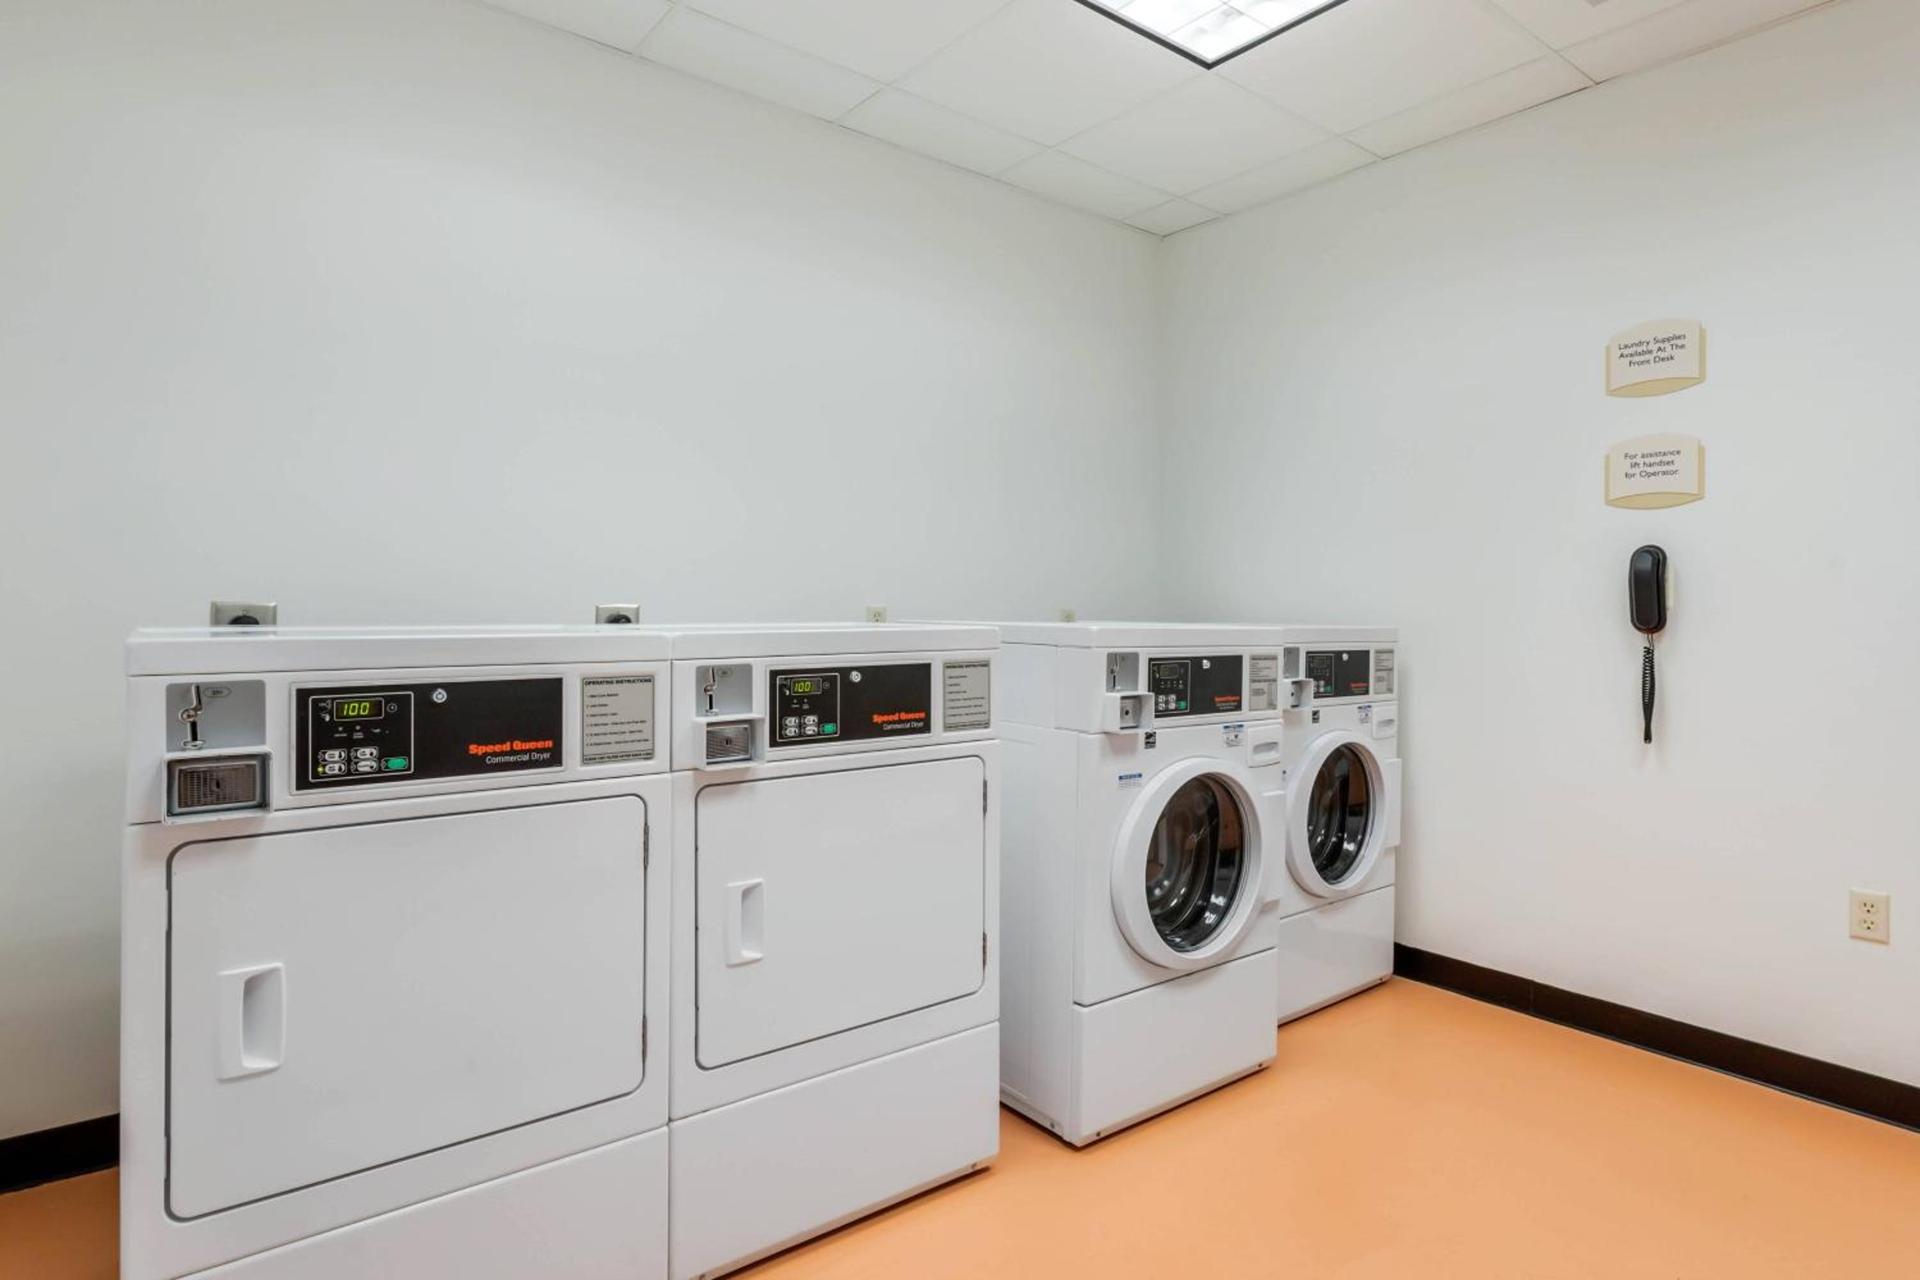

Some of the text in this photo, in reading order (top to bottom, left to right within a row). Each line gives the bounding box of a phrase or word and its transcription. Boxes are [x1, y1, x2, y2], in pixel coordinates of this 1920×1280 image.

[1618, 334, 1687, 351] Laundry Supplies
[1618, 343, 1687, 360] Available At The
[1629, 354, 1676, 368] Front Desk
[1624, 450, 1681, 460] For assistance
[1630, 460, 1675, 469] lift handset
[1625, 471, 1637, 479] for
[794, 681, 811, 692] 100
[342, 702, 370, 716] 100
[873, 711, 926, 724] Speed Queen
[468, 740, 553, 756] Speed Queen
[485, 752, 552, 764] Commercial Dryer
